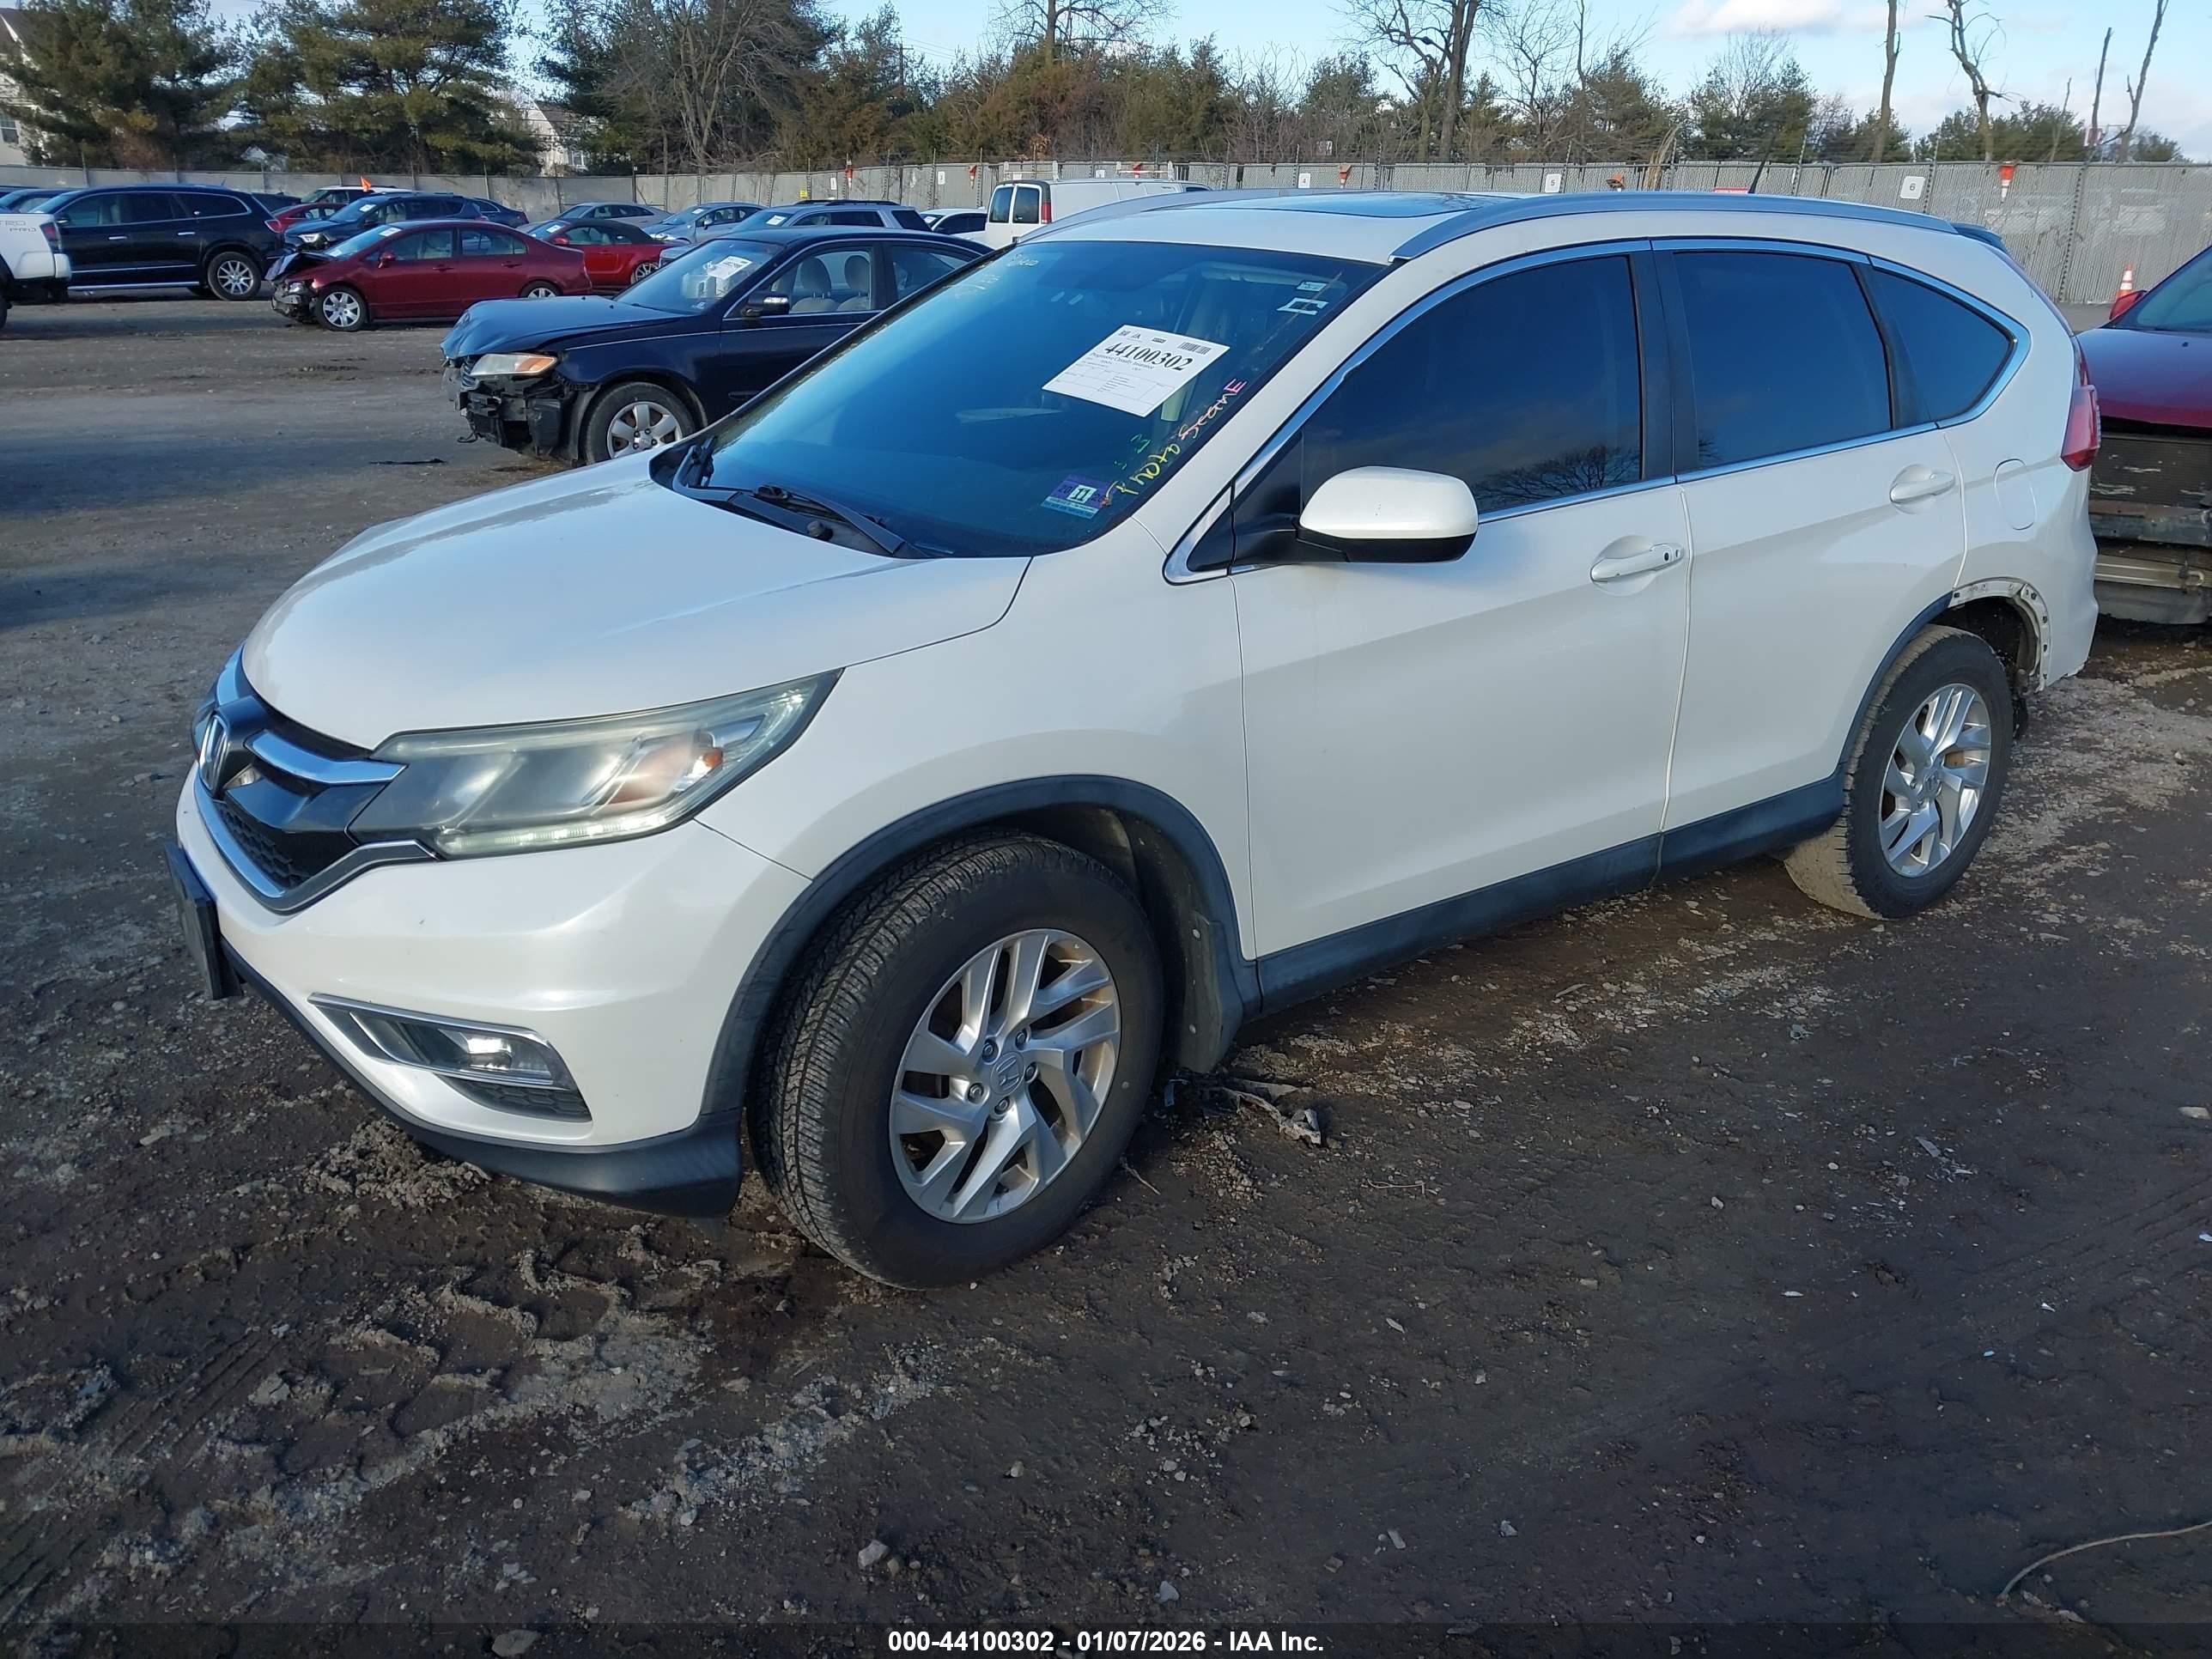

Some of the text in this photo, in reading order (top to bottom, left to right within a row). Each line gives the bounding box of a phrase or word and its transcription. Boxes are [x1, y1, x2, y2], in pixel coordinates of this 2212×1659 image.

[1909, 182, 1916, 191] 6
[1104, 342, 1193, 371] 44100302
[1070, 488, 1091, 501] 11
